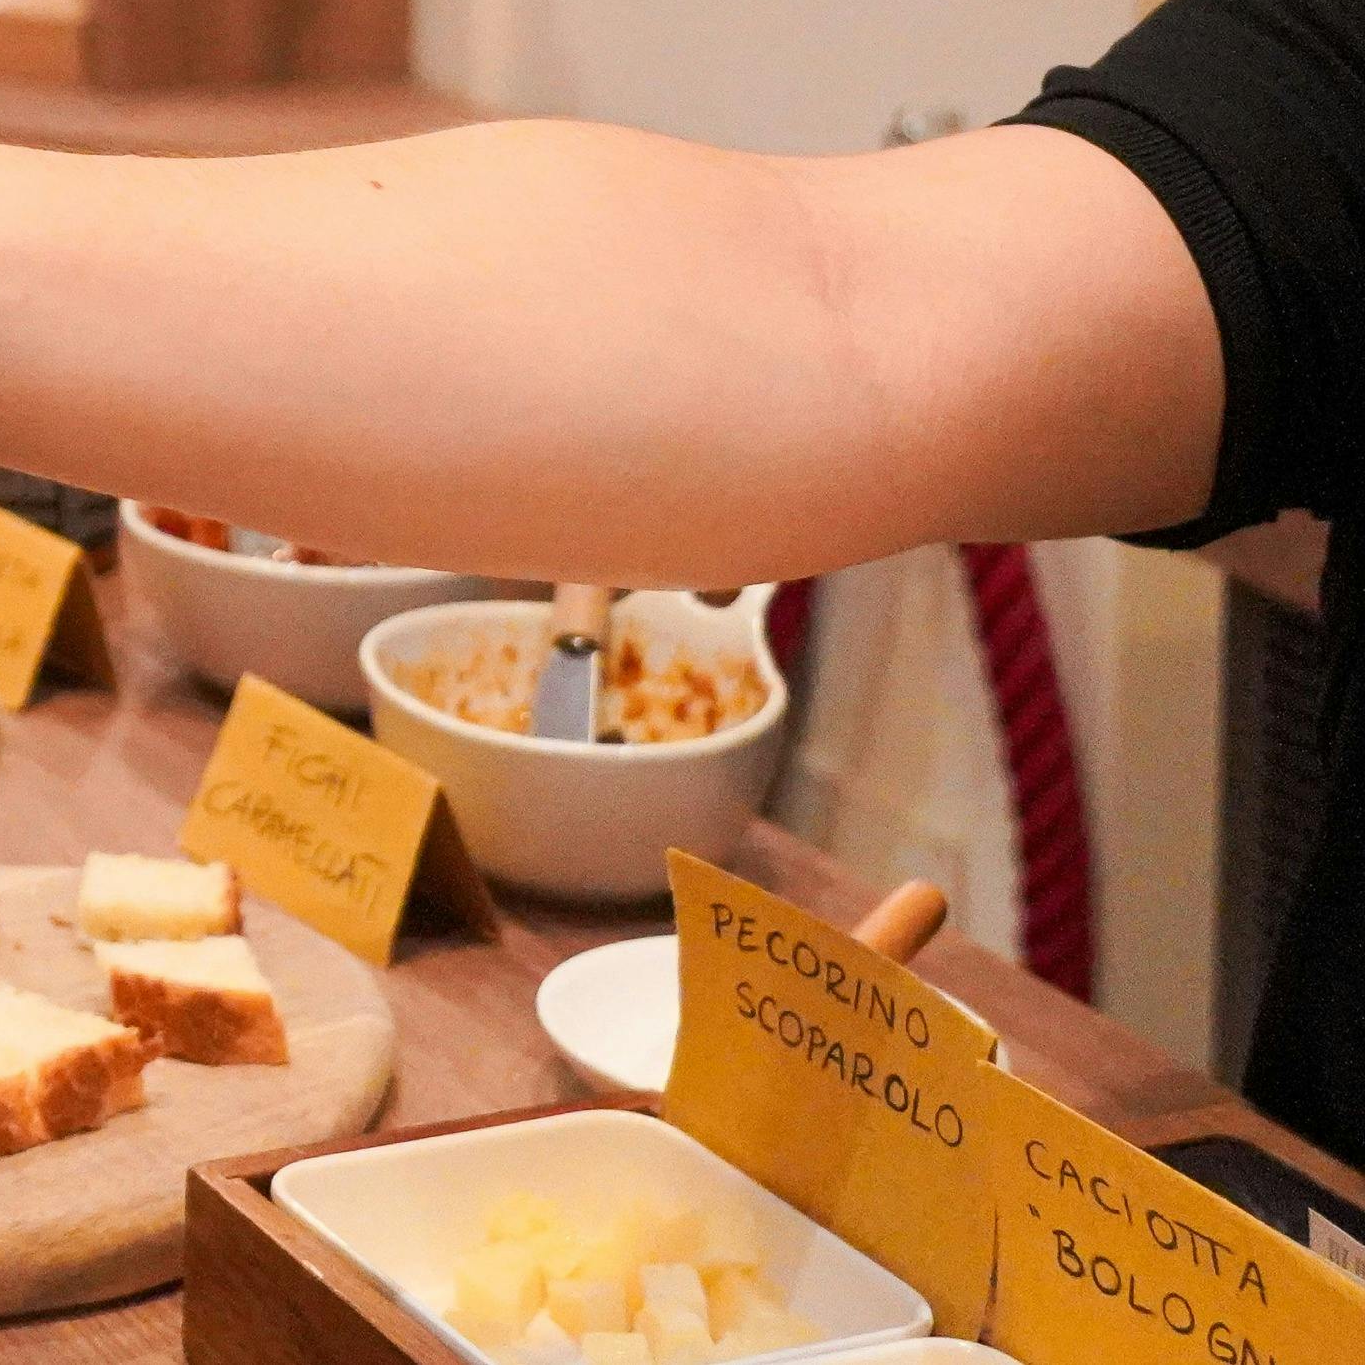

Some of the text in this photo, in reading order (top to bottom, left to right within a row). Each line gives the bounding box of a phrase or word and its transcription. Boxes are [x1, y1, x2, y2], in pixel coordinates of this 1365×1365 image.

[710, 903, 930, 1049] PECORINO
[736, 981, 964, 1149] SCOPAROLO
[1024, 1140, 1268, 1306] CACIOTTA
